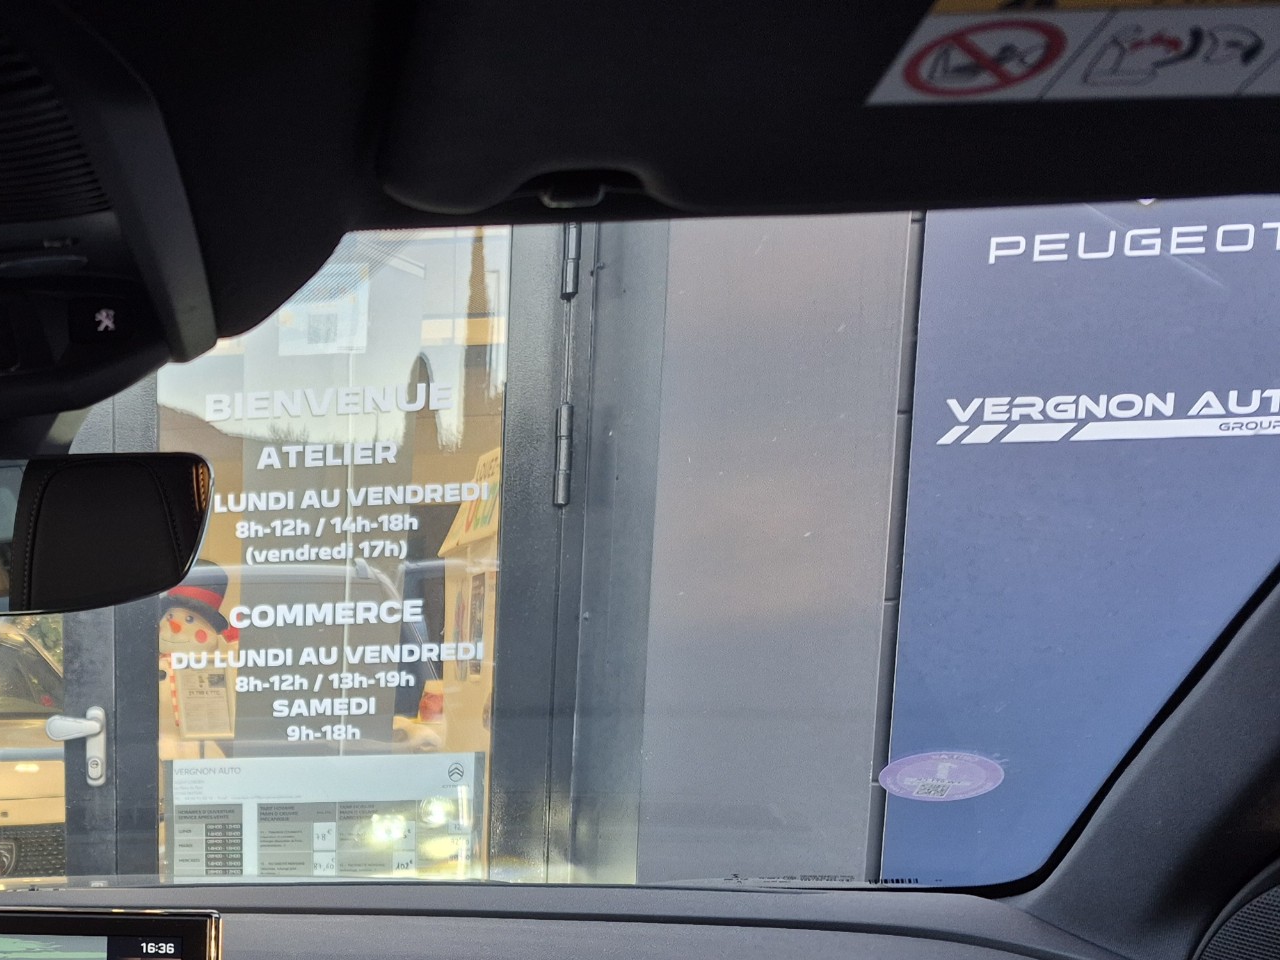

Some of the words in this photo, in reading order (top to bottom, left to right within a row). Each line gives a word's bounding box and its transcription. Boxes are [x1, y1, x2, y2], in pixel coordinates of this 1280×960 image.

[205, 381, 454, 422] BIENVENUE
[946, 392, 1175, 423] VERGNON
[256, 441, 397, 470] ATELIER
[214, 491, 294, 514] LUNDI
[300, 488, 339, 510] AU
[347, 482, 489, 507] VENDREDI
[235, 520, 310, 539] 8h-12h
[315, 519, 323, 538] /
[331, 513, 418, 534] 14h-18h
[246, 542, 354, 566] (vendredi
[359, 540, 408, 561] 17h)
[229, 600, 424, 629] COMMERCE
[171, 651, 209, 670] DU
[214, 647, 293, 669] LUNDI
[299, 646, 338, 665] AU
[345, 642, 484, 664] VENDREDI
[235, 674, 308, 693] 8h-12h
[313, 674, 322, 692] /
[329, 672, 415, 691] 13h-19h
[272, 697, 376, 718] SAMEDI
[287, 724, 360, 742] 9h-18h
[174, 767, 216, 776] VERGNON
[218, 767, 242, 775] AUTO
[140, 942, 175, 954] 16:36
